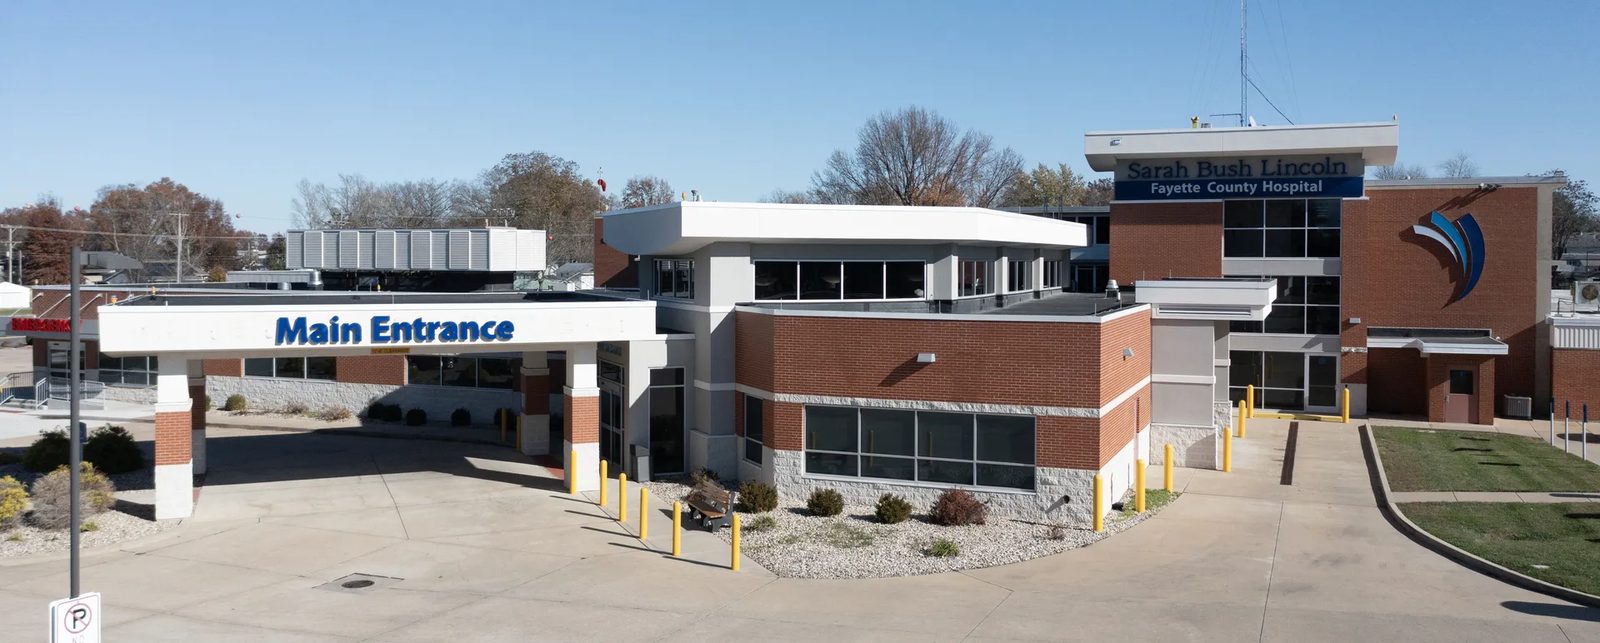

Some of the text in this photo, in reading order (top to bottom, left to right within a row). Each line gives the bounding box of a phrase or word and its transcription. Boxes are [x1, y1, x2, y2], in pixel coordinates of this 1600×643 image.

[1127, 157, 1347, 179] Sarah Bush Lincoln
[1151, 180, 1323, 196] Fayette County Hospital
[275, 315, 515, 346] Main Entrance
